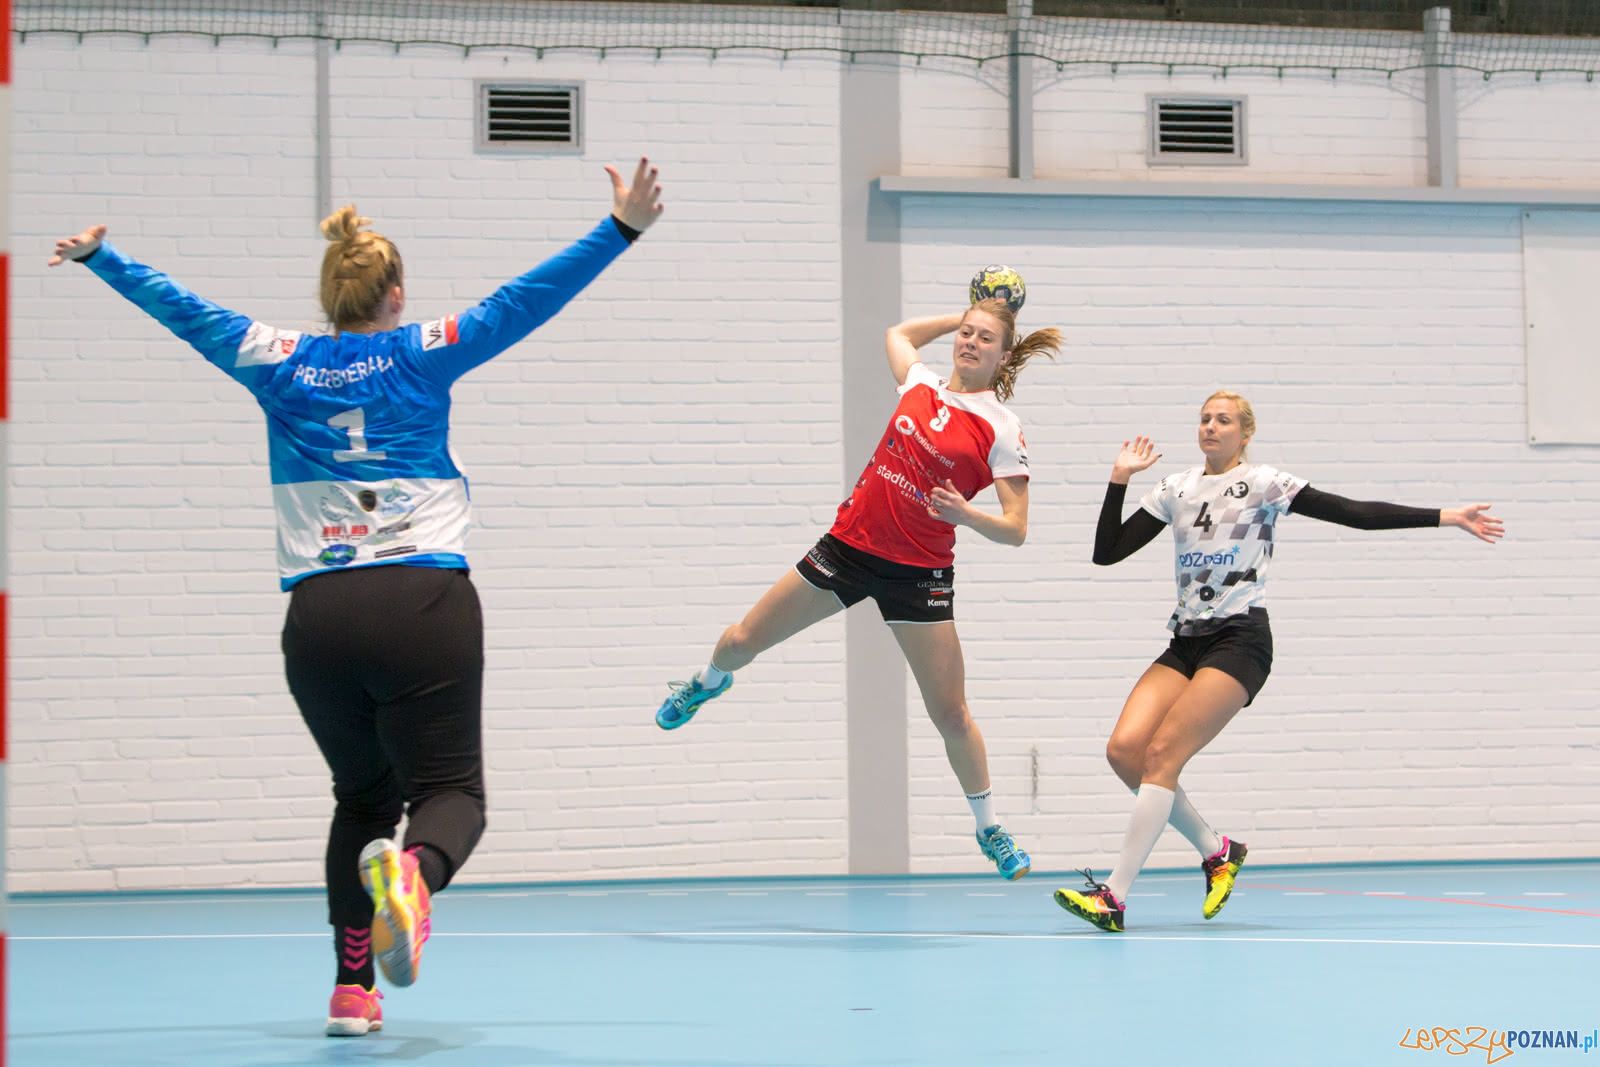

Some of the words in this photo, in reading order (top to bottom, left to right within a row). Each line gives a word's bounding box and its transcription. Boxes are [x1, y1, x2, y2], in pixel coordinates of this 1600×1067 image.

[327, 406, 387, 462] 1
[914, 431, 956, 470] holistic-net
[1193, 501, 1212, 533] 4
[927, 599, 950, 608] Kemp
